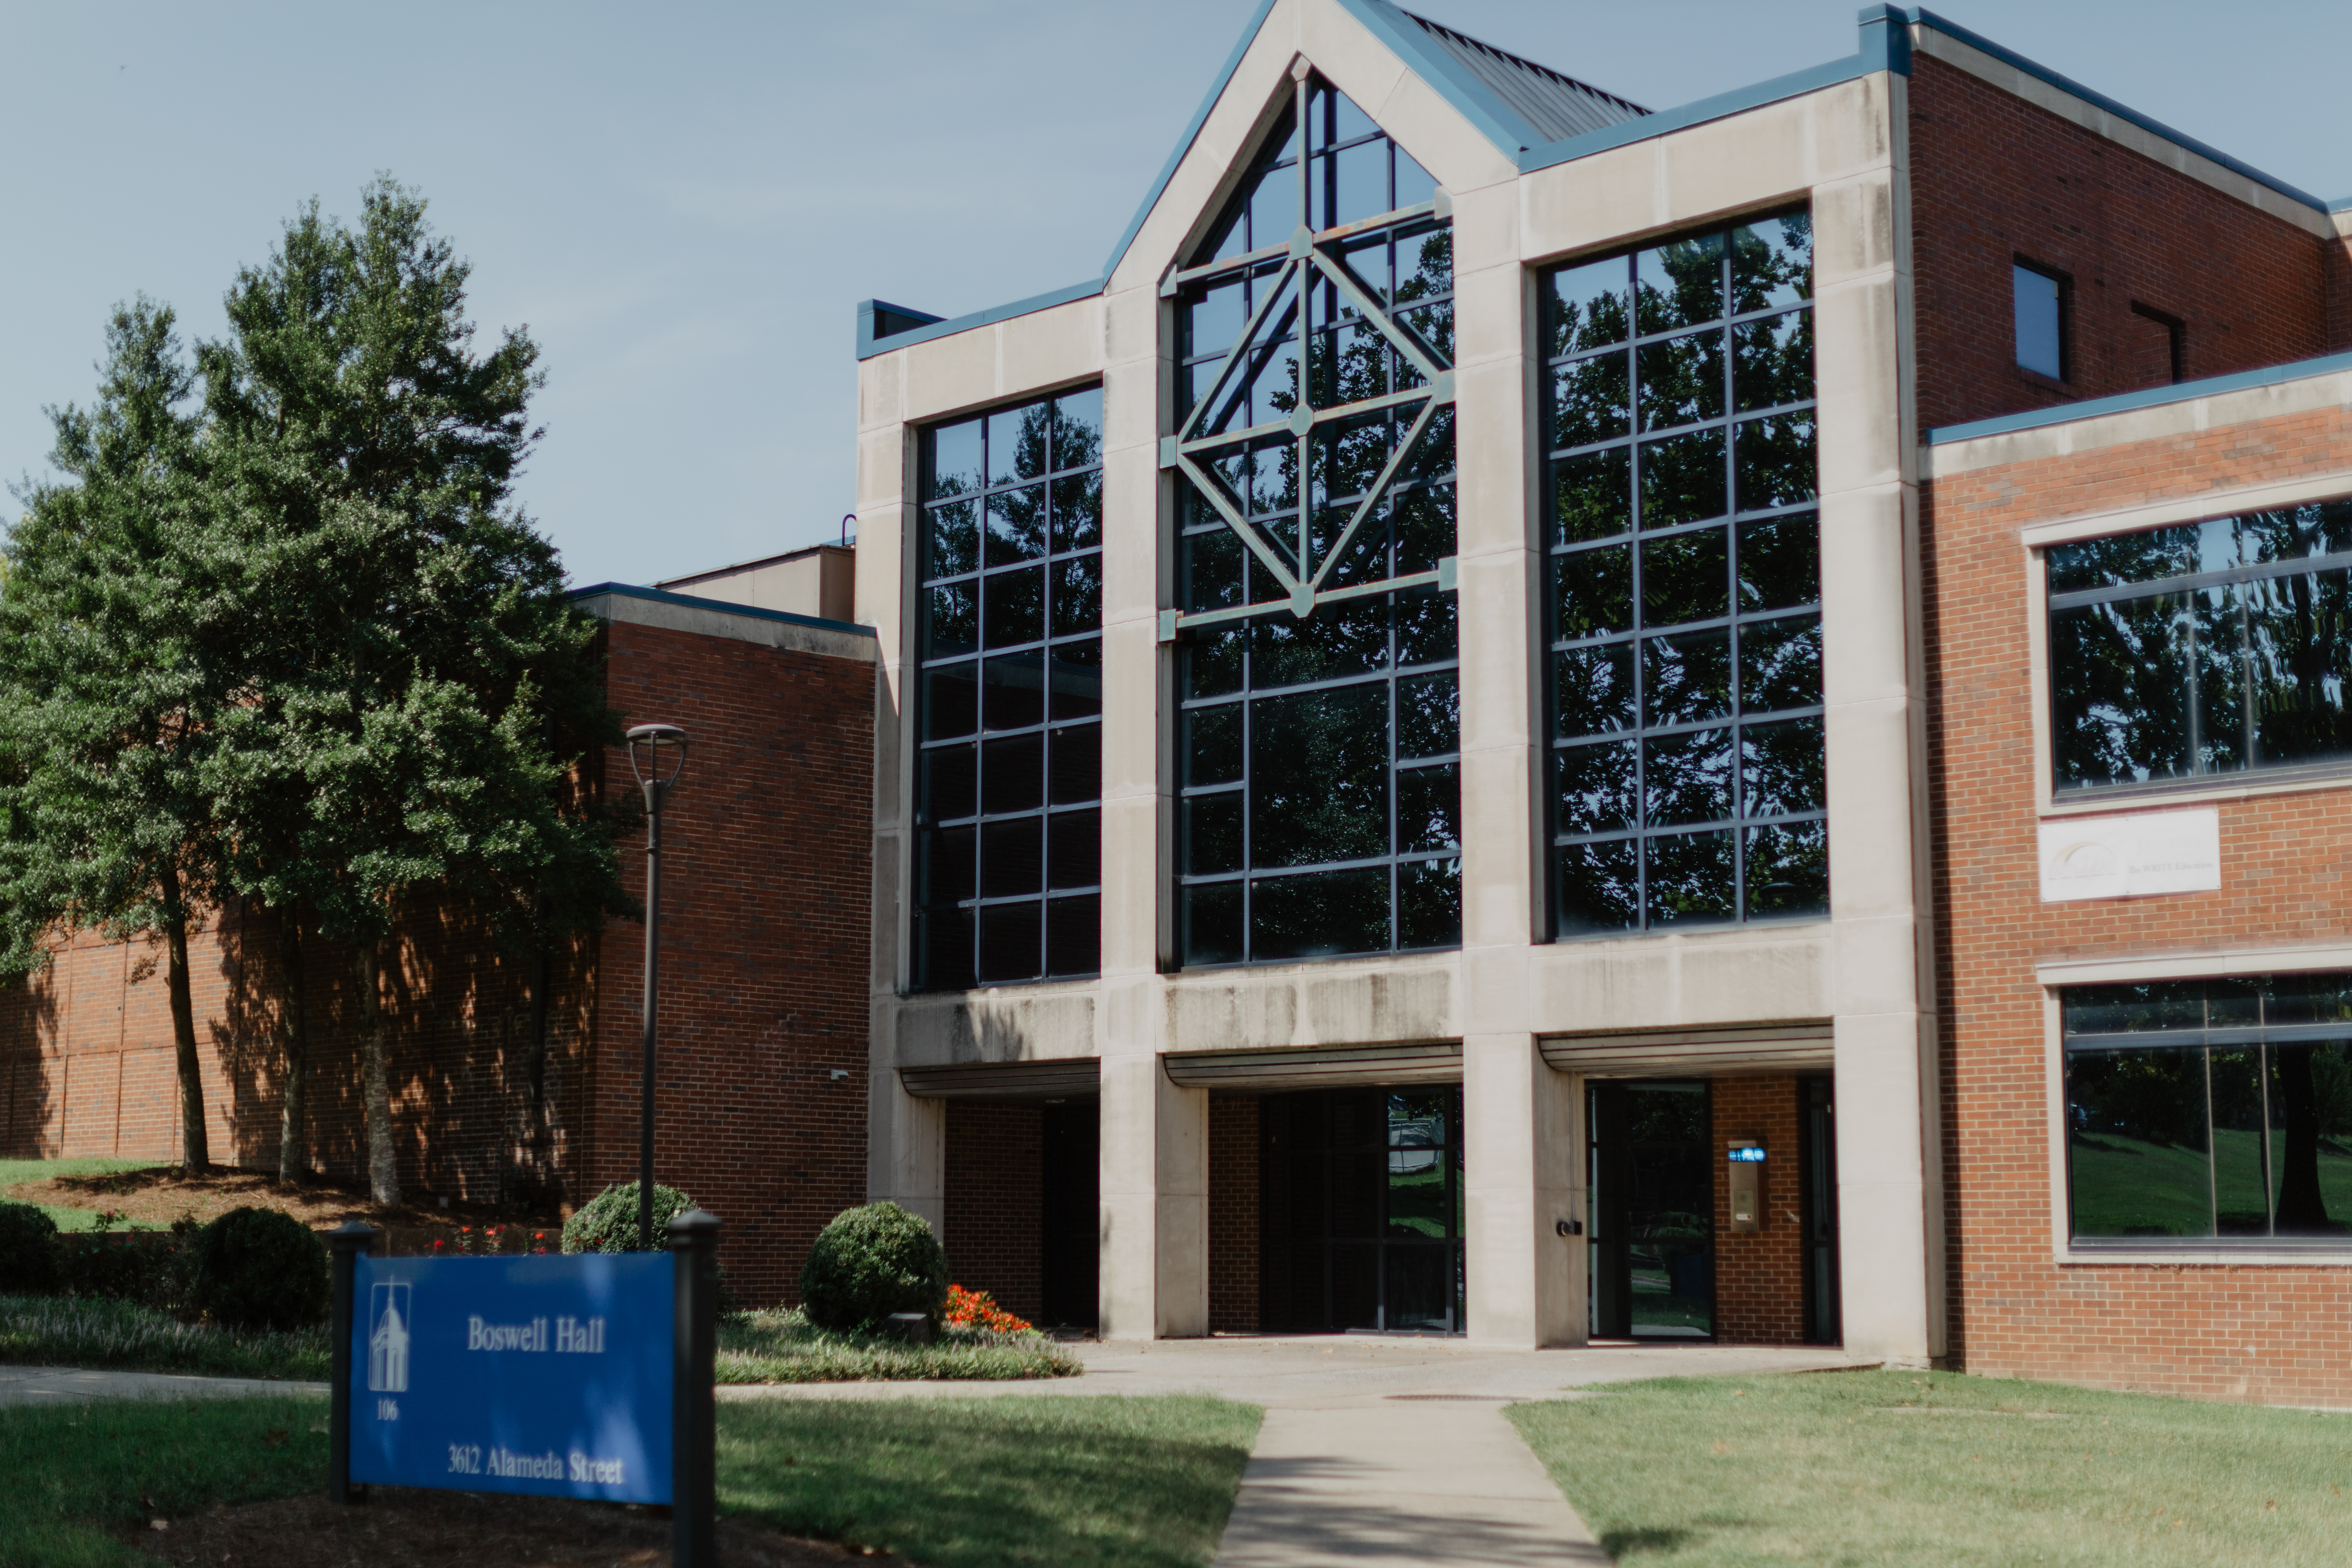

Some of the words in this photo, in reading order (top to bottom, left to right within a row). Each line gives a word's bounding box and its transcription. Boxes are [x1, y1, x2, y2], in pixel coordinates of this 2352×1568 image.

[2143, 863, 2174, 872] WRITE
[2175, 862, 2213, 871] Education
[468, 1316, 548, 1352] Boswell
[555, 1316, 604, 1353] Hall
[377, 1399, 398, 1421] 106
[448, 1445, 480, 1474] 3612
[486, 1447, 564, 1480] Alameda
[570, 1450, 623, 1484] Street
